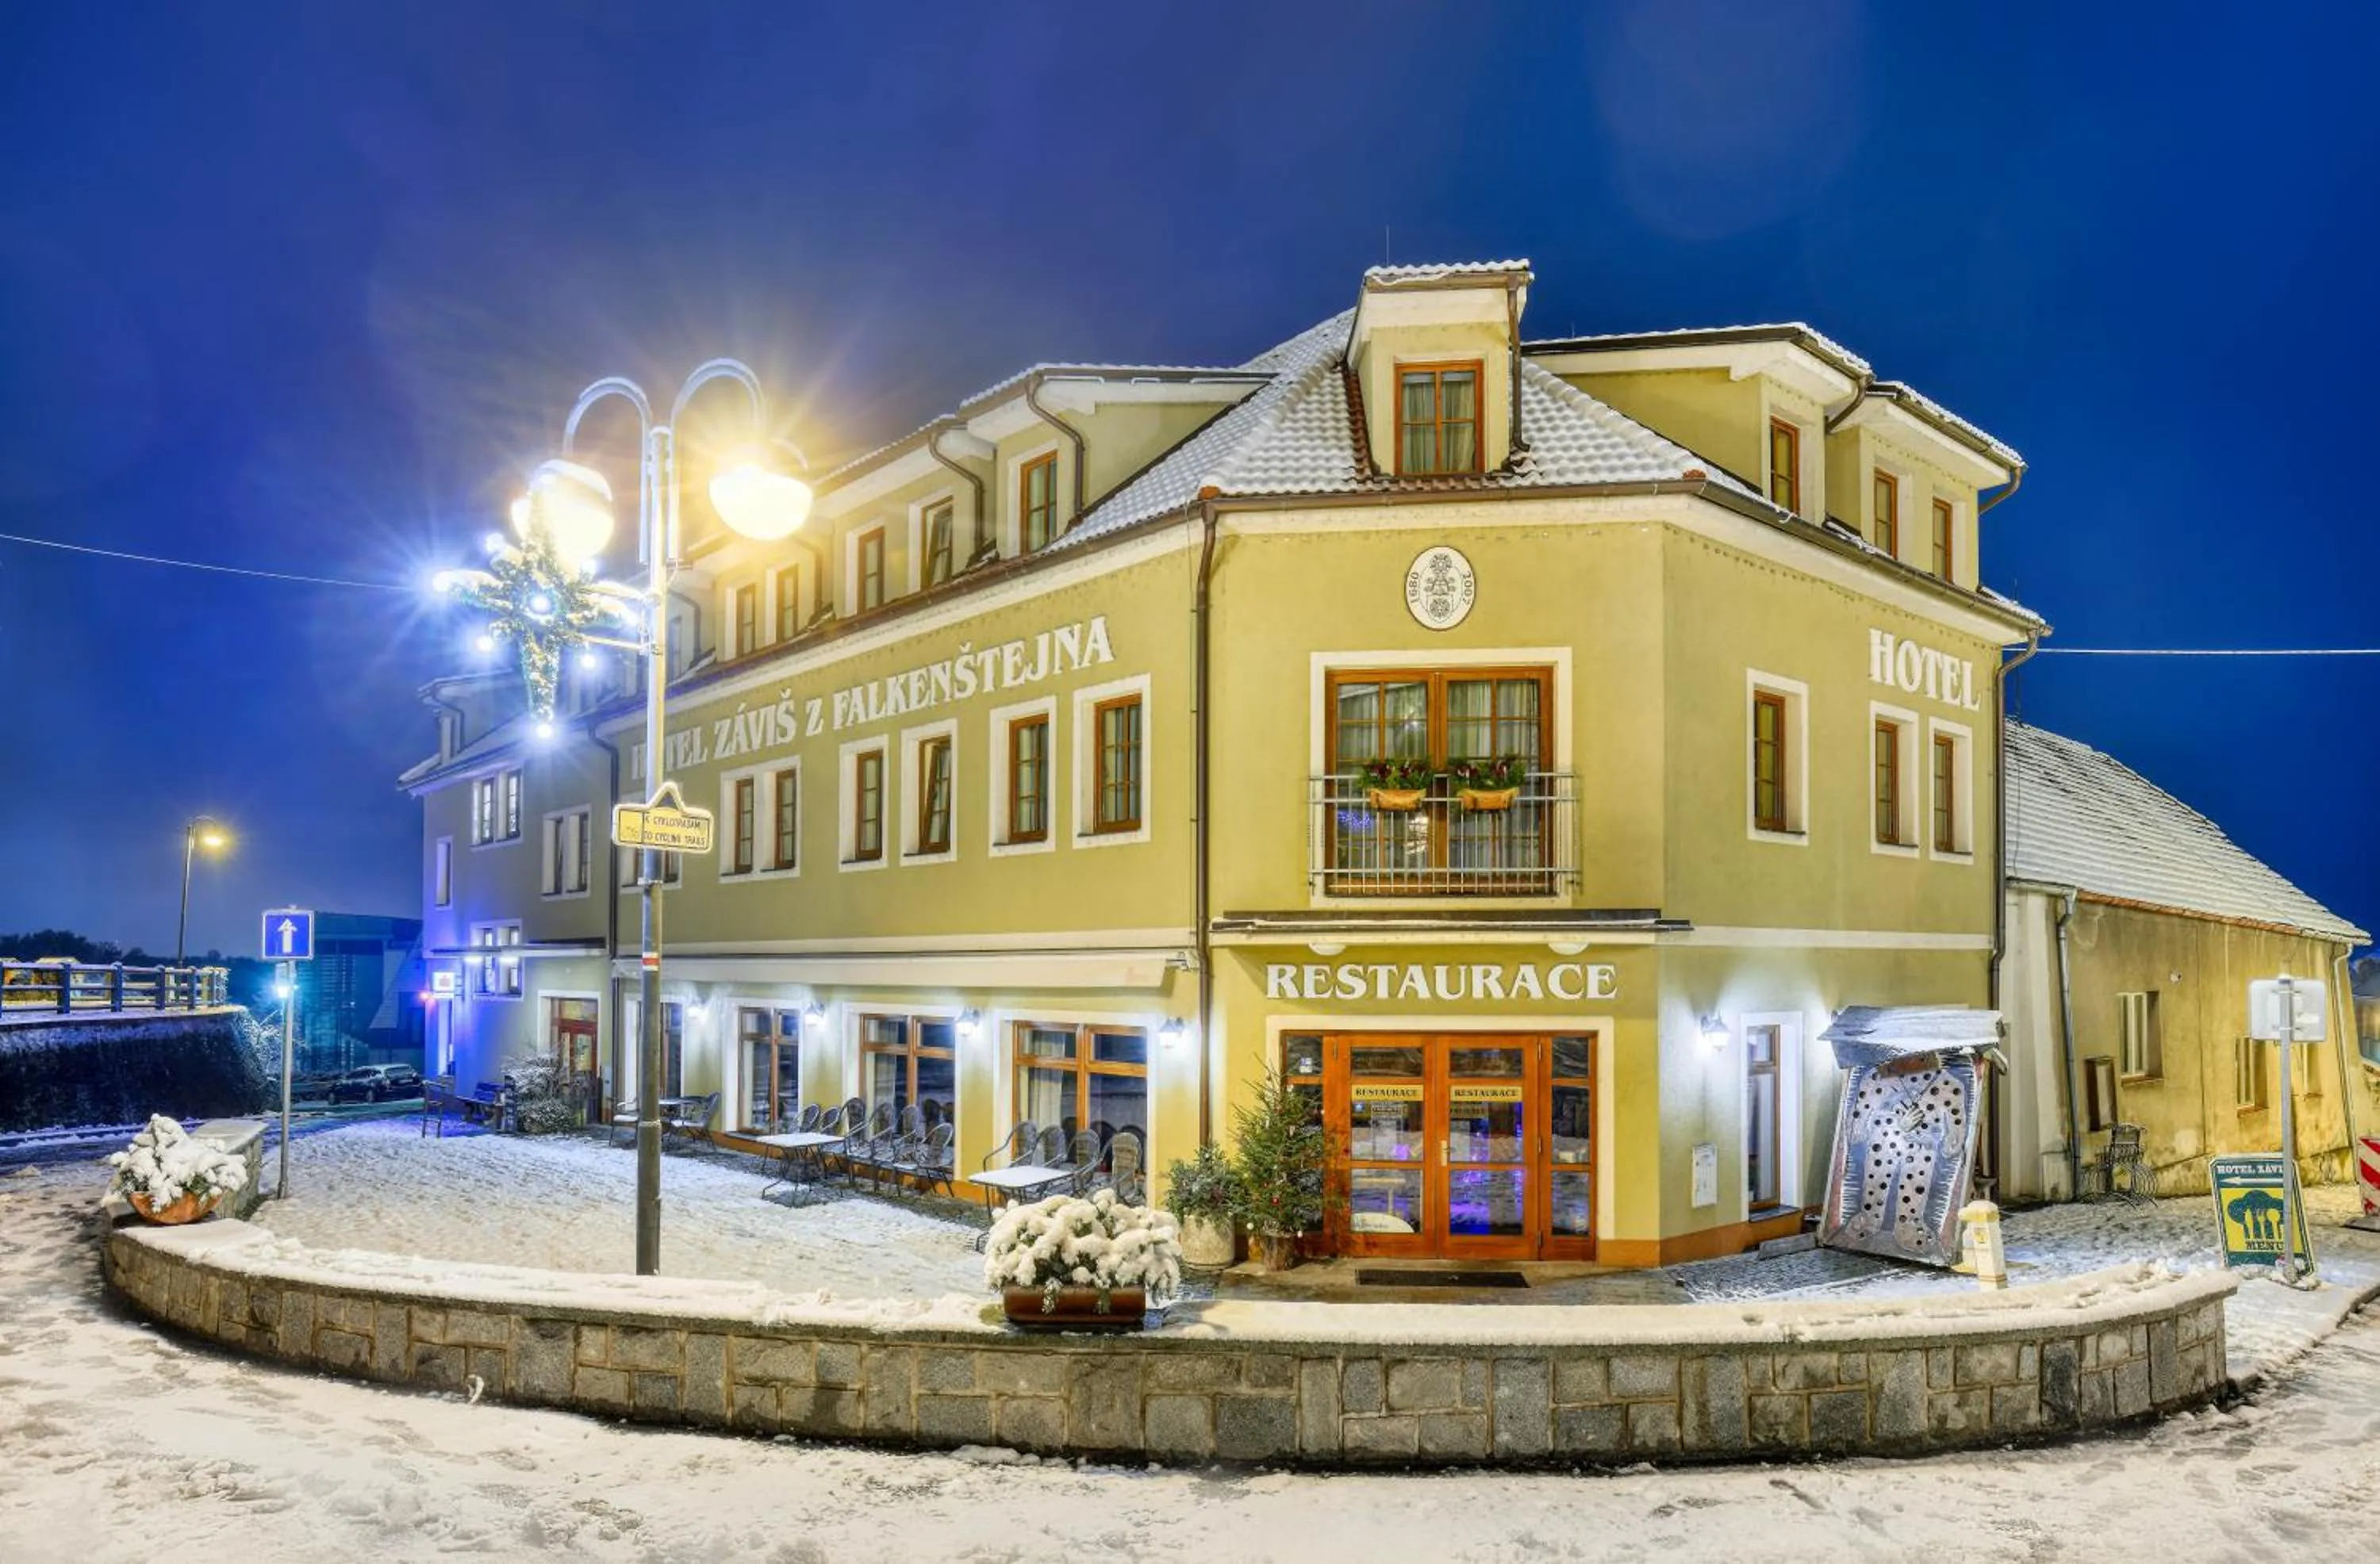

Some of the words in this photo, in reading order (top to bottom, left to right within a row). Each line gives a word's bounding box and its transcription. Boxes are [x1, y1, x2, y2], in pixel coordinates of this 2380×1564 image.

[1868, 627, 1981, 711] HOTEL
[631, 726, 708, 780] HTEL
[714, 688, 797, 760] ZÁVIŠ
[805, 698, 823, 736] Z
[832, 615, 1115, 730] FALKENŠTEJNA
[1266, 964, 1618, 999] RESTAURACE
[1356, 1088, 1418, 1098] RESTAURACE
[1454, 1089, 1518, 1098] RESTAURACE
[2216, 1164, 2255, 1174] HOTEL
[2257, 1163, 2283, 1174] ZÁVI
[2245, 1240, 2284, 1251] MENU
